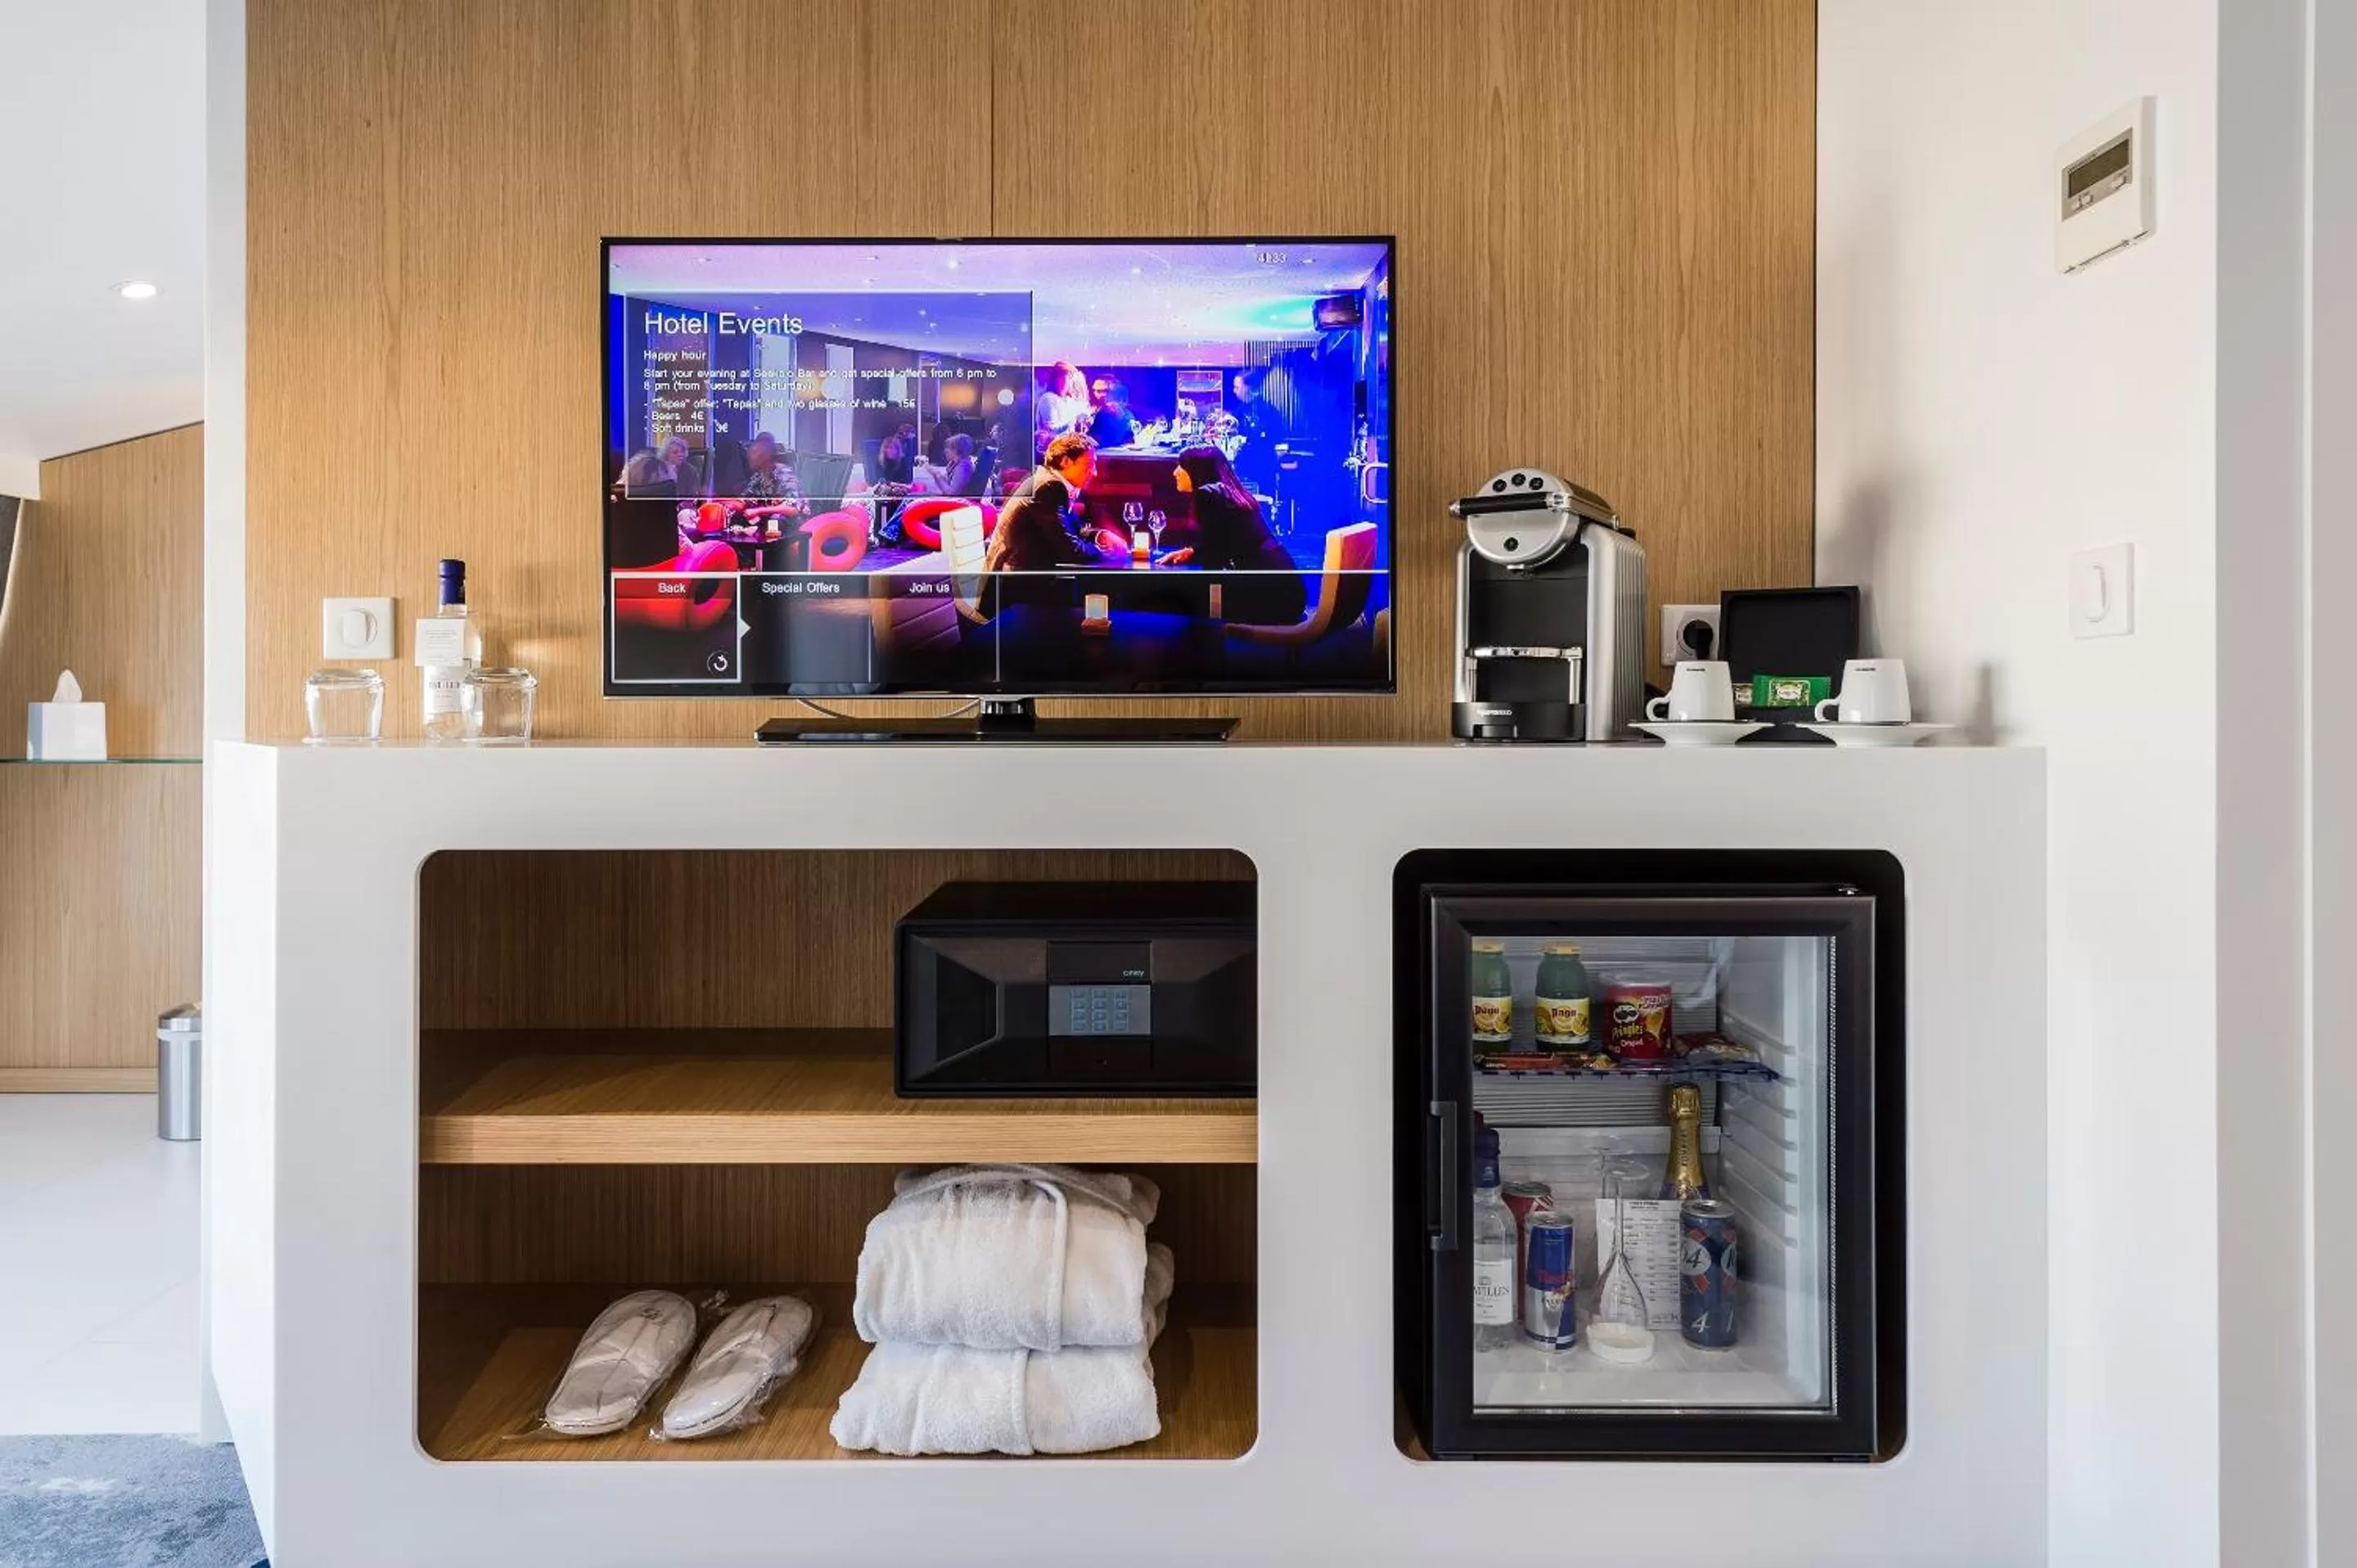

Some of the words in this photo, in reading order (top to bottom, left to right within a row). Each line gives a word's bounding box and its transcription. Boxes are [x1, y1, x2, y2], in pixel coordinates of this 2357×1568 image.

[644, 312, 708, 335] Hotel
[719, 312, 804, 335] Events
[643, 350, 678, 362] Happy
[681, 349, 706, 361] hour
[643, 368, 668, 378] Start
[672, 370, 694, 381] your
[697, 368, 737, 381] evening
[740, 369, 750, 378] at
[931, 368, 953, 378] from
[957, 368, 963, 378] 6
[967, 370, 983, 381] pm
[986, 369, 997, 378] to
[655, 382, 670, 392] pm
[674, 380, 700, 392] (from
[704, 380, 746, 393] Tuesday
[750, 381, 759, 390] to
[764, 399, 783, 408] and
[850, 399, 860, 408] of
[863, 399, 887, 408] wine
[651, 411, 681, 421] Beers
[651, 423, 673, 433] Soft
[675, 422, 705, 433] drinks
[657, 582, 687, 593] Back
[762, 582, 803, 596] Special
[806, 582, 840, 593] Offers
[909, 582, 933, 593] Join
[935, 583, 950, 593] us
